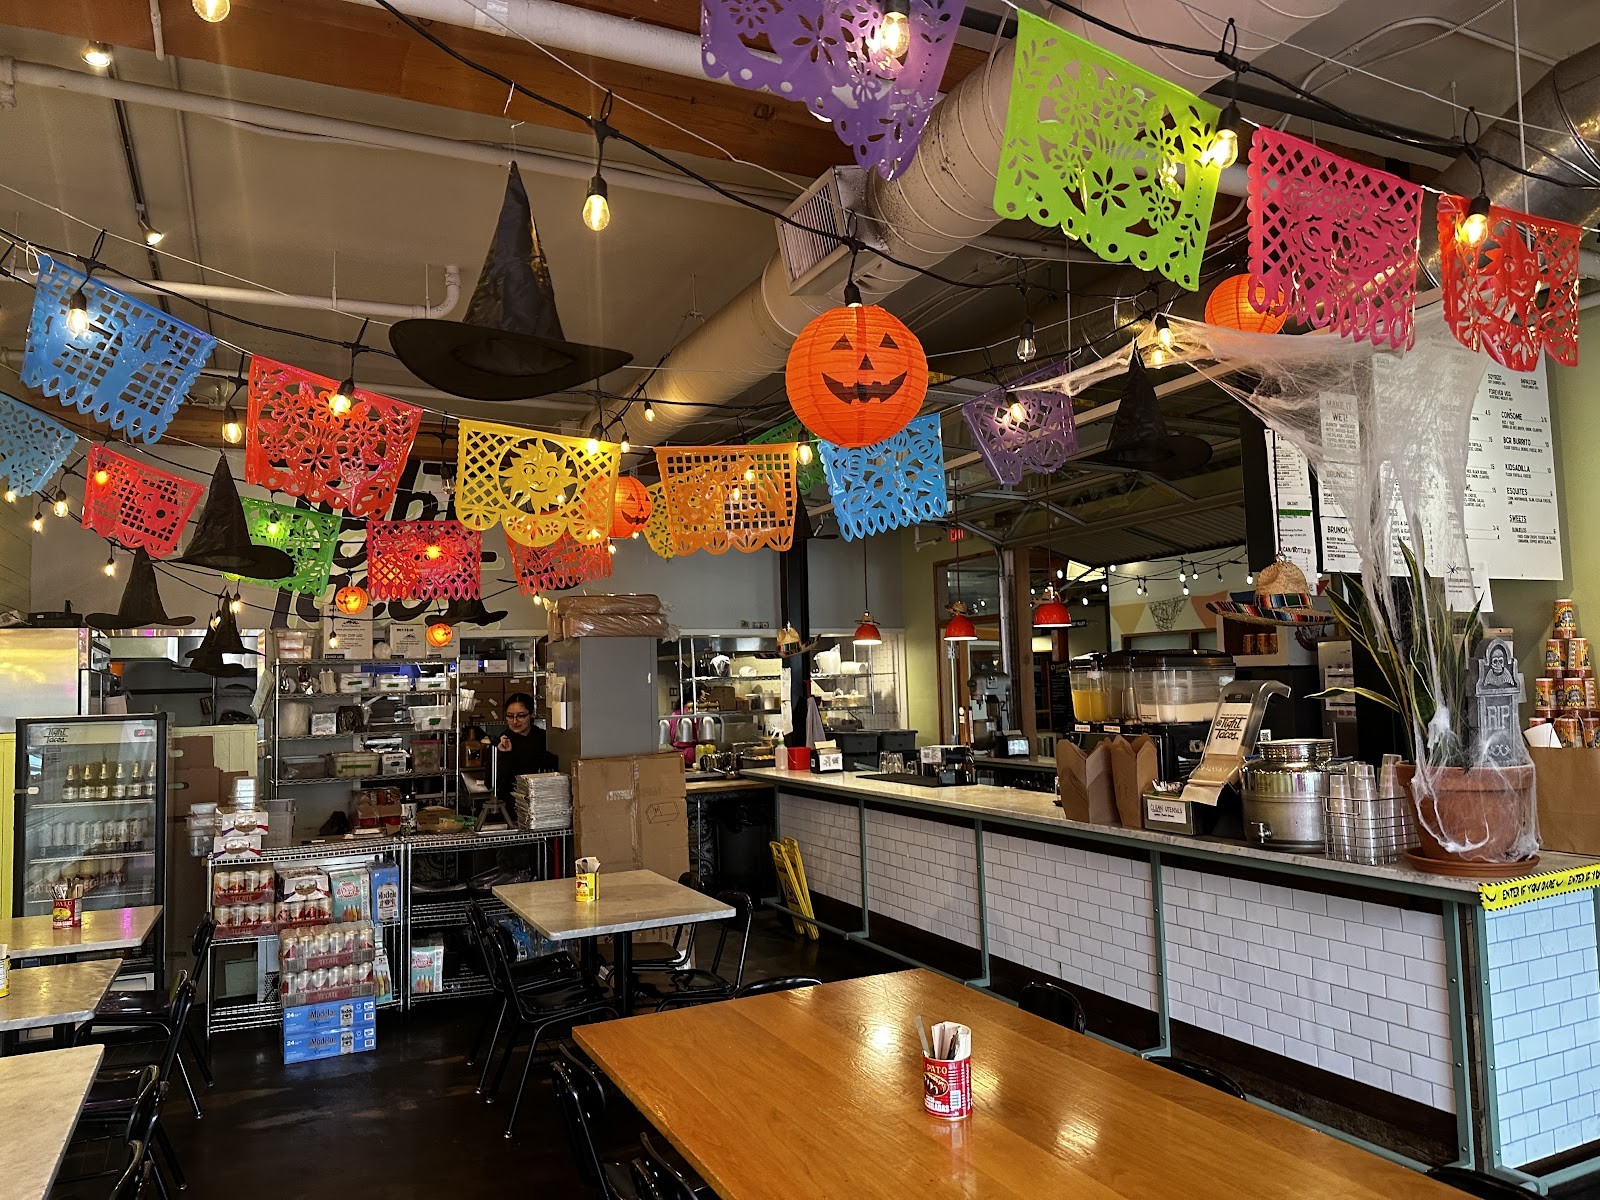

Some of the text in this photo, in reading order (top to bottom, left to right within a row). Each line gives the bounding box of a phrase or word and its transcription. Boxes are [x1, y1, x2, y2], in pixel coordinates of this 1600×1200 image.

[1513, 438, 1531, 446] BURRITO
[1505, 464, 1530, 472] KIDSADILLA
[1507, 487, 1528, 495] ESQUITES
[1509, 514, 1527, 523] SWEETS
[1327, 526, 1348, 534] BRUNCH
[1486, 704, 1510, 730] RIP
[1502, 886, 1519, 900] ENTER
[1520, 886, 1527, 896] IF
[1528, 882, 1540, 894] YOU
[1567, 873, 1584, 885] ENTER
[1585, 872, 1590, 882] IF
[926, 1064, 948, 1074] PATO
